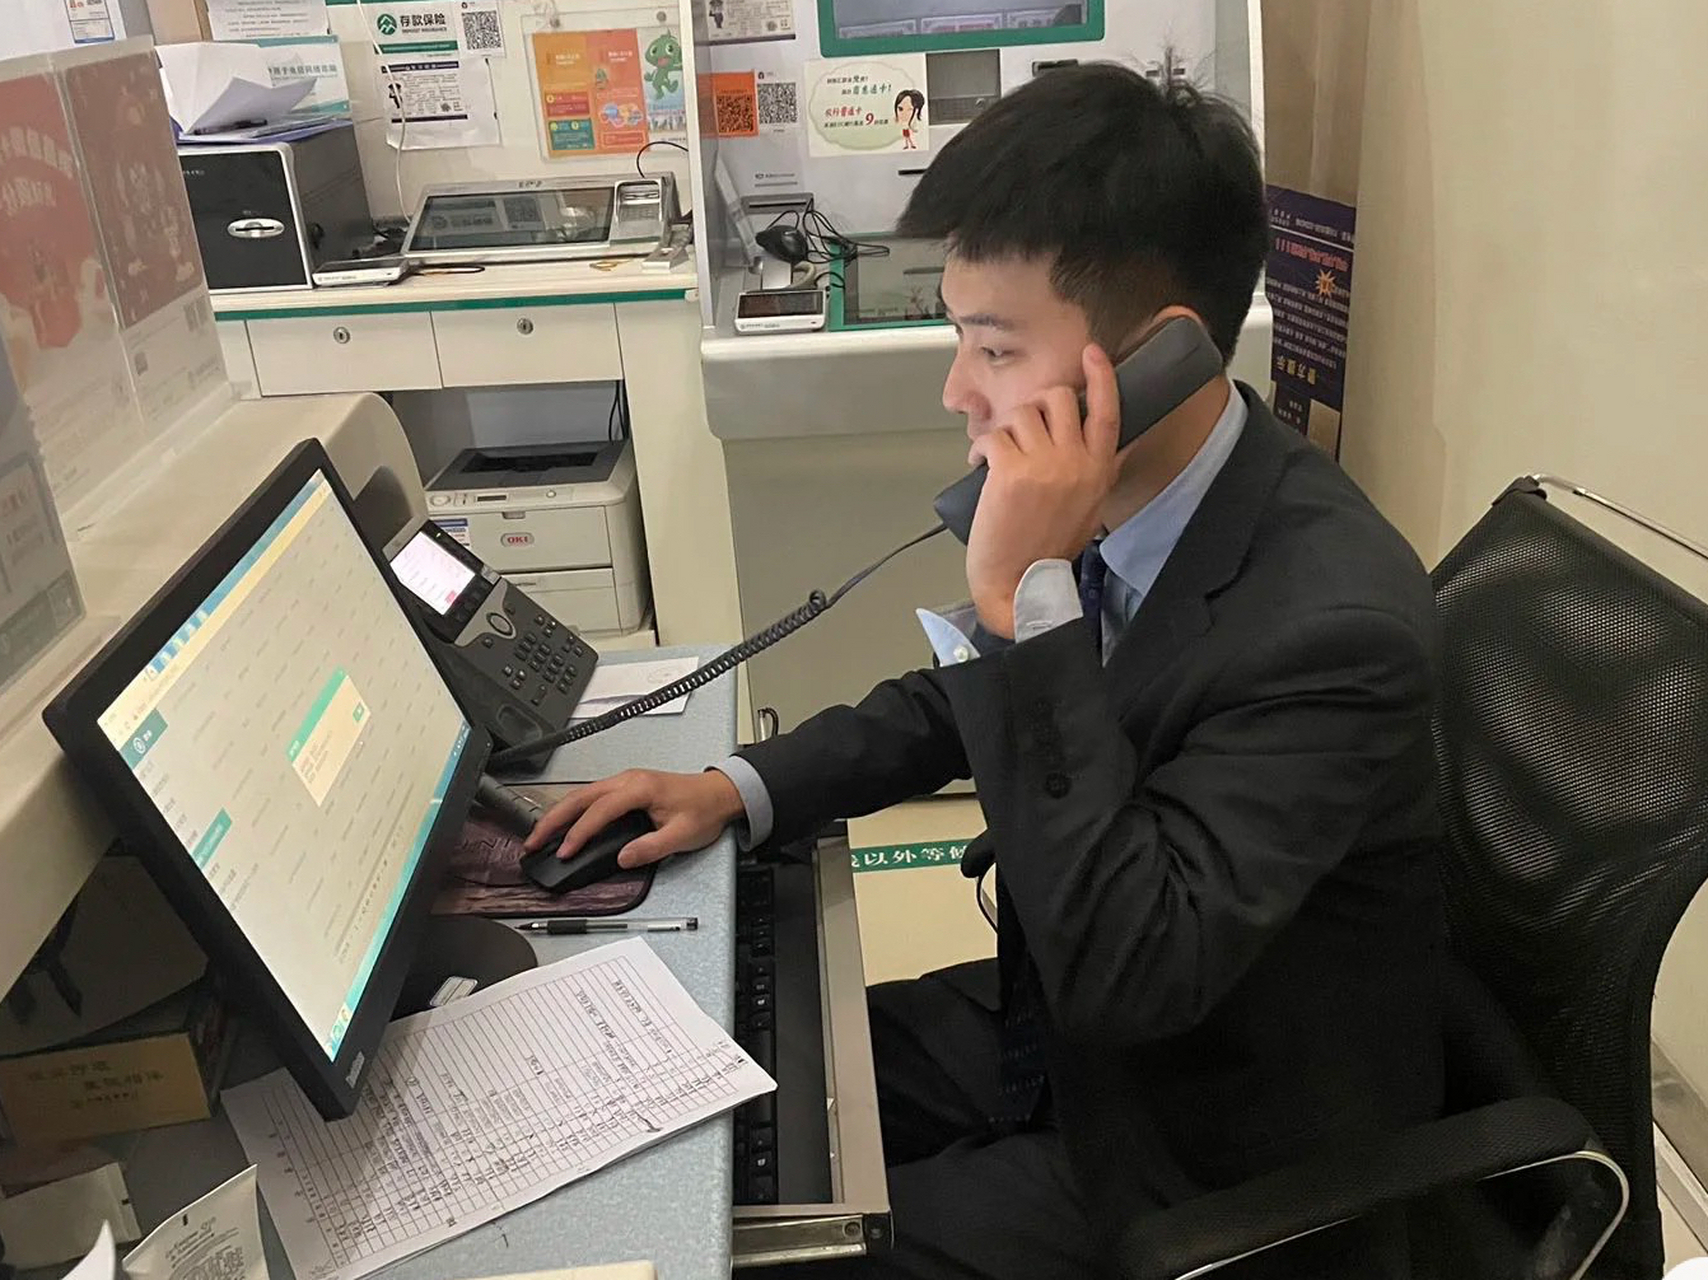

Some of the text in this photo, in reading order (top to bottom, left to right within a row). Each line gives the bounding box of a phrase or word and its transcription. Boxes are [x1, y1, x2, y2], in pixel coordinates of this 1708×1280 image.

[399, 13, 446, 27] 存款保险
[507, 536, 529, 544] OKI
